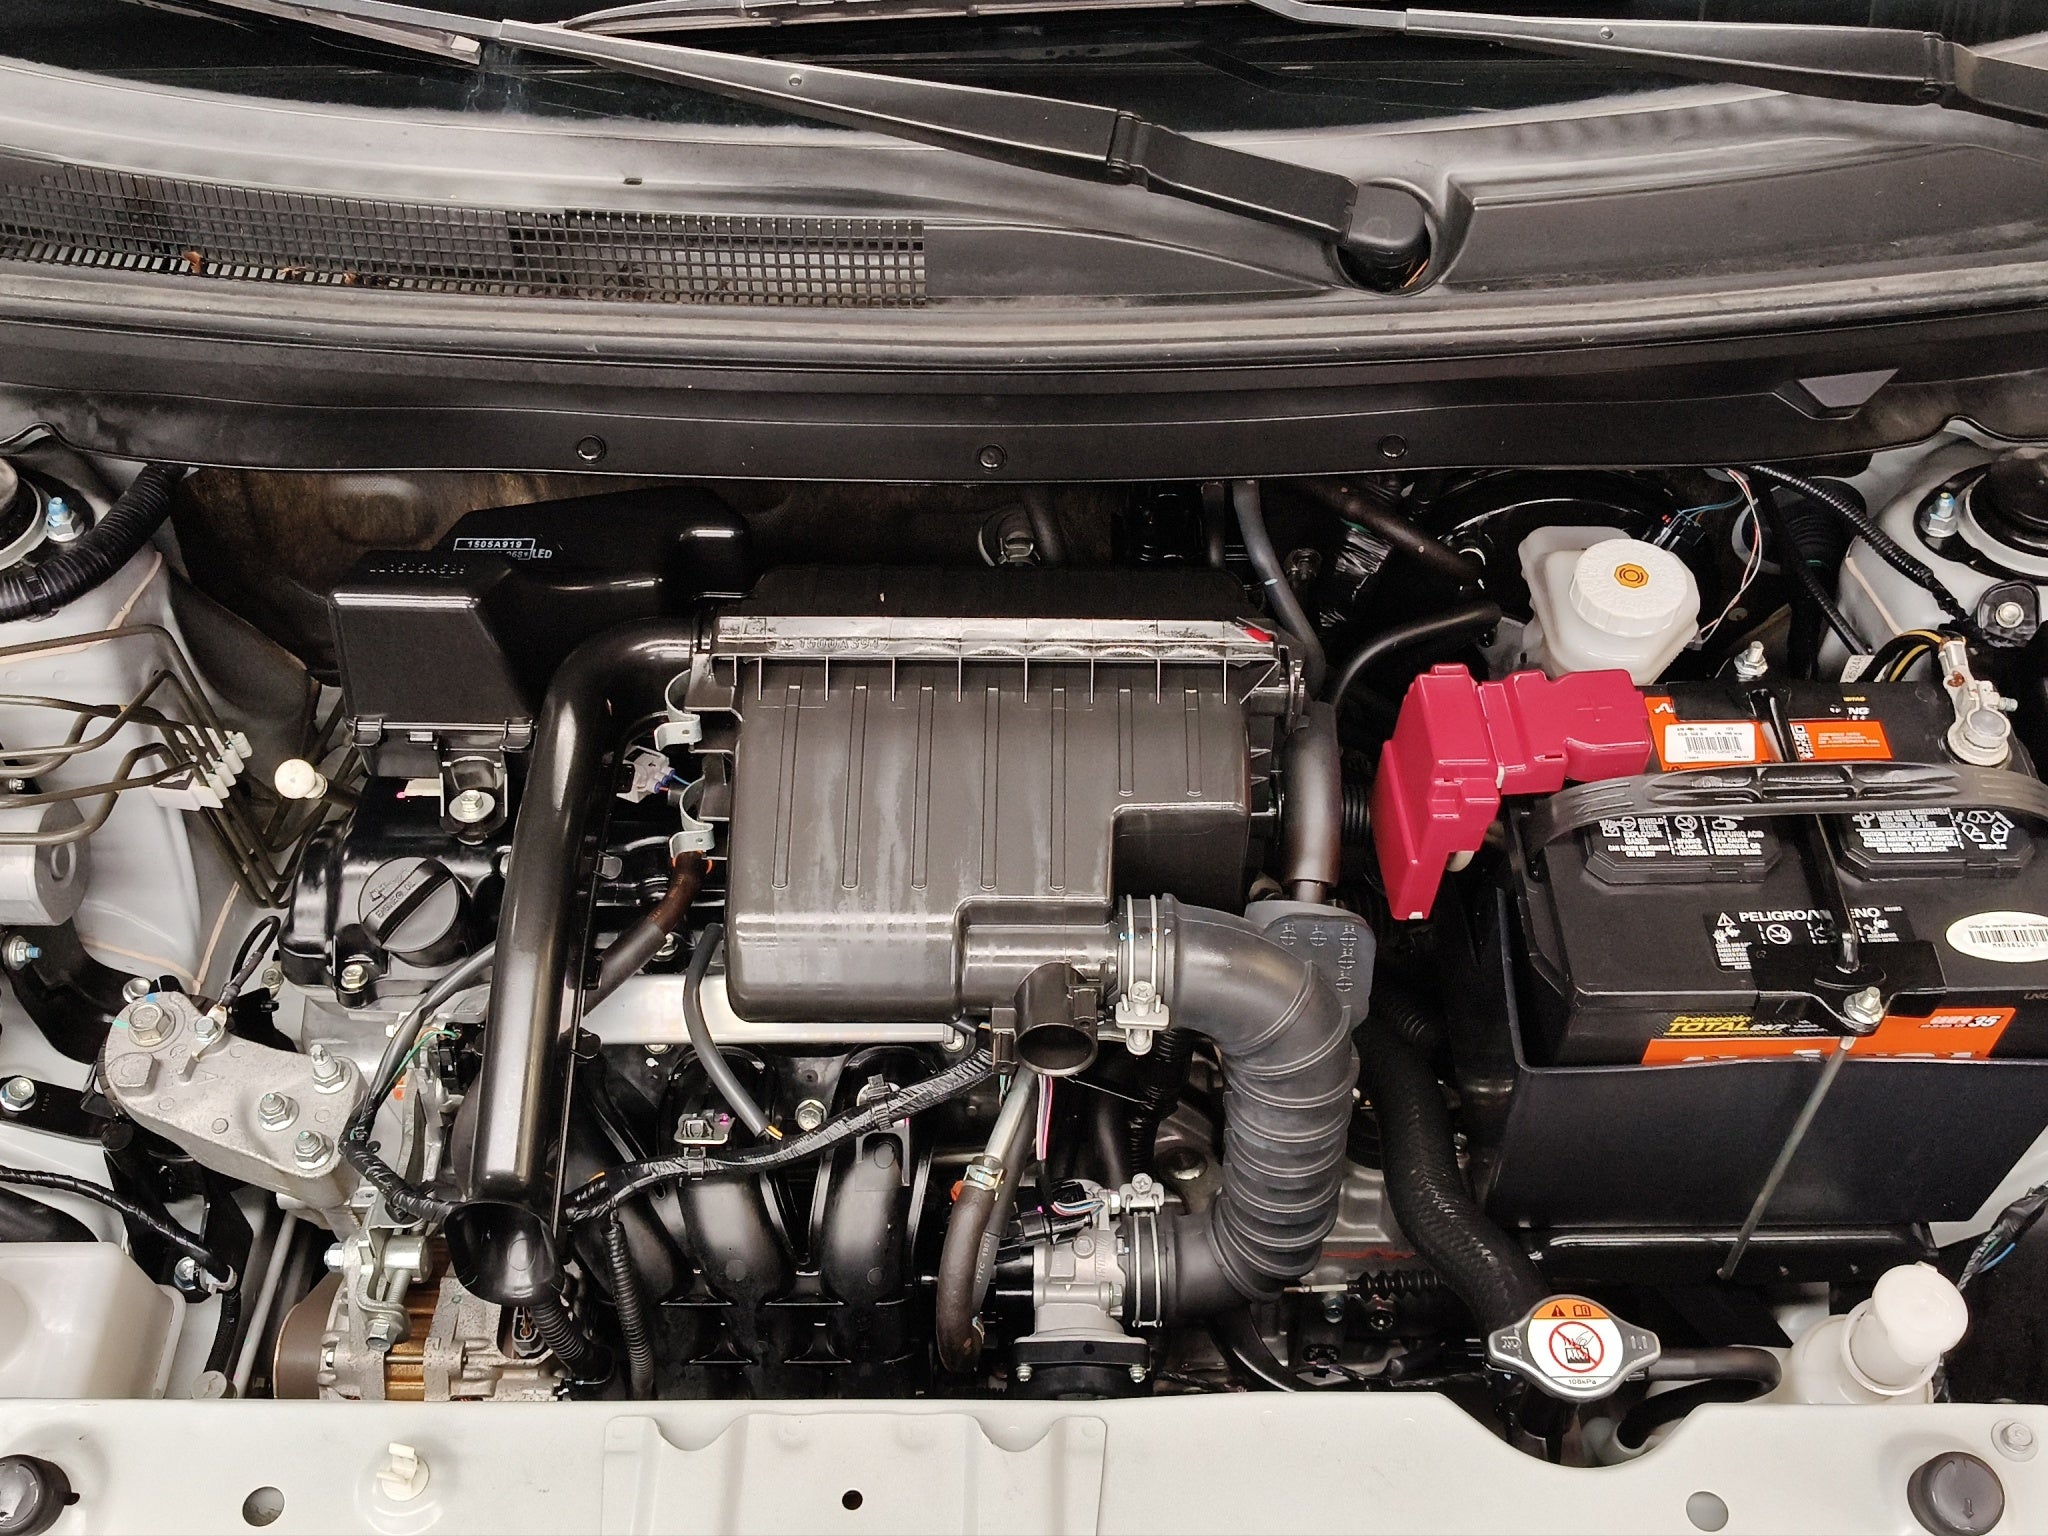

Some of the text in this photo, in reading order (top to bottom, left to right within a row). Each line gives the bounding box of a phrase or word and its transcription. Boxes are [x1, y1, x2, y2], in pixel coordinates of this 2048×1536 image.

[1673, 1014, 1751, 1022] Protección
[1968, 1016, 2001, 1028] 35
[1669, 1022, 1749, 1032] TOTAL
